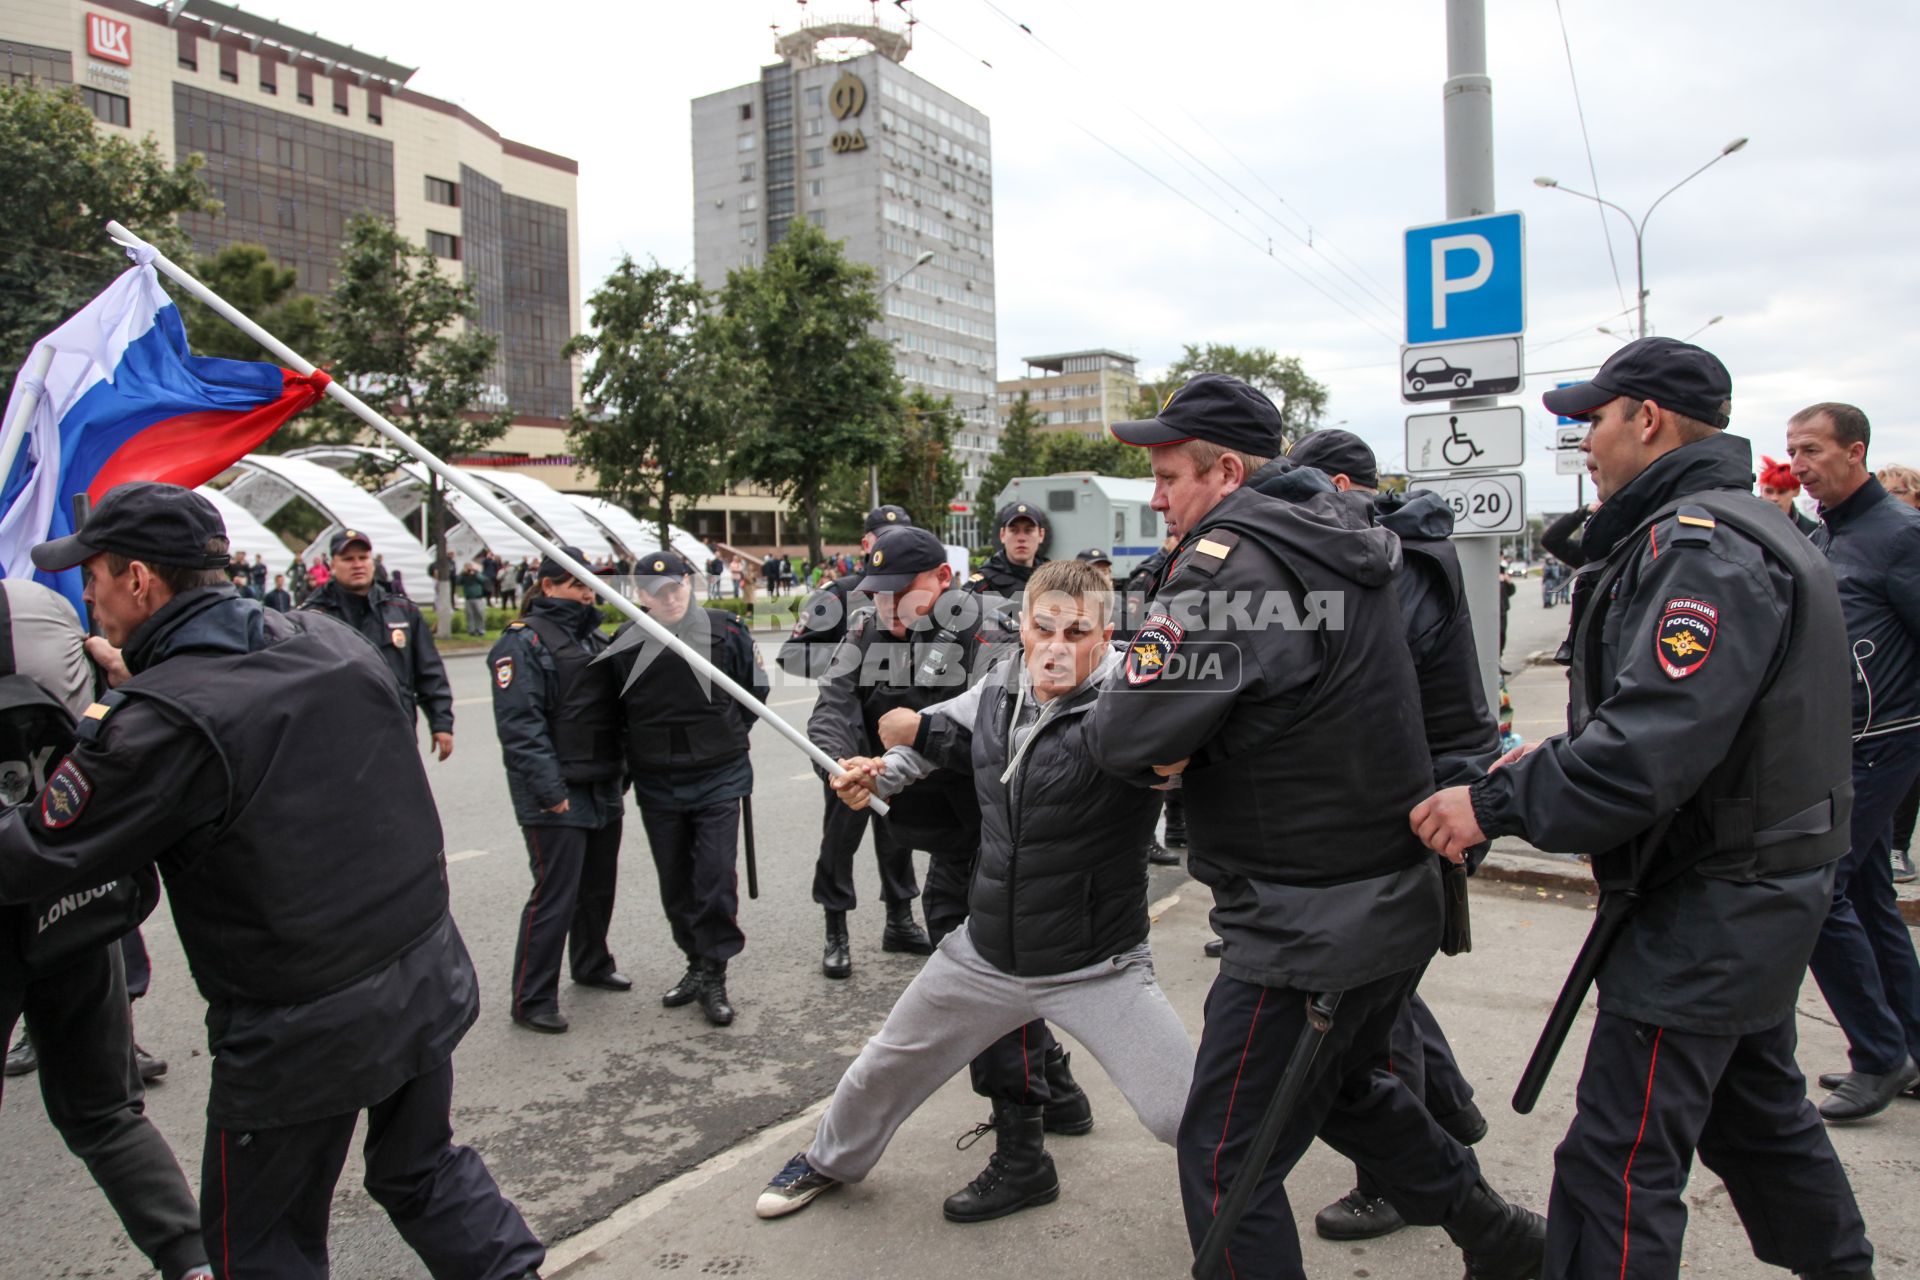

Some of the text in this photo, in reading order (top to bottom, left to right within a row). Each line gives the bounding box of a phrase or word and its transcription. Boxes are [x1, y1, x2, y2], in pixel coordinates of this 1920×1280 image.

[1431, 233, 1494, 330] P
[1473, 493, 1500, 514] 20
[1670, 600, 1715, 619] ПОЛИЦИЯ
[1151, 615, 1181, 638] ПОЛИЦИЯ
[1666, 617, 1710, 637] РОССИЯ
[1142, 630, 1172, 653] РОССИЯ
[1666, 663, 1687, 678] МВД
[56, 773, 80, 805] РОССИЯ
